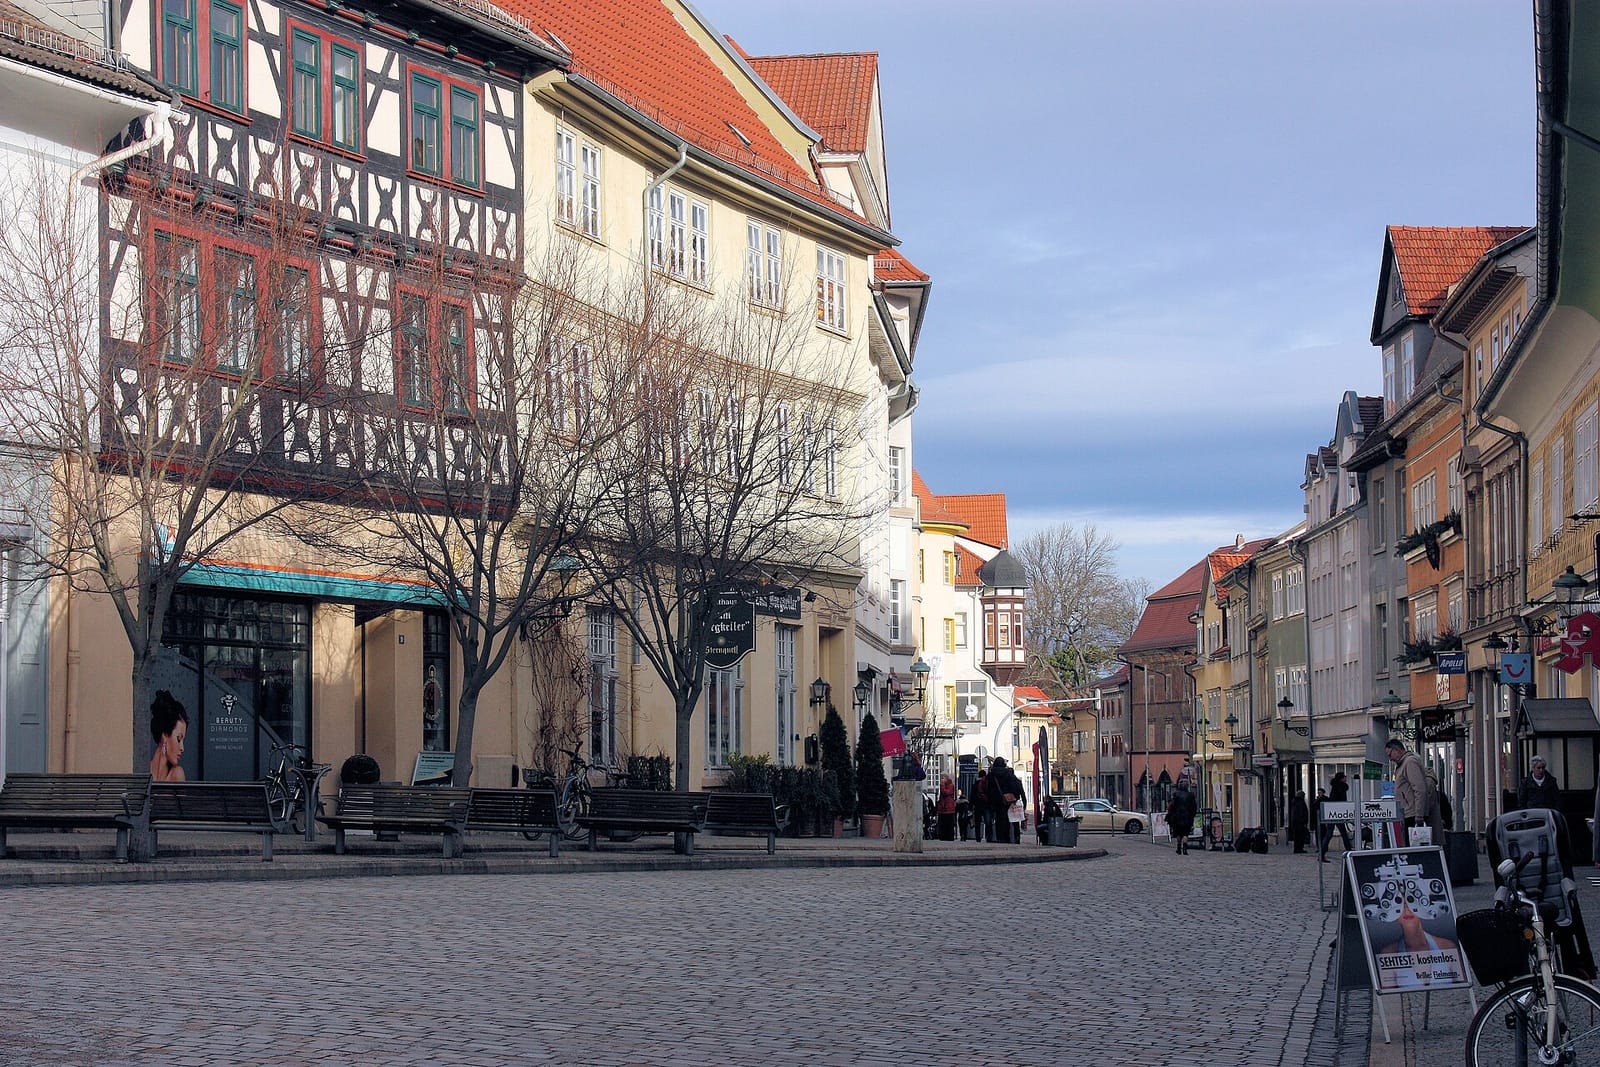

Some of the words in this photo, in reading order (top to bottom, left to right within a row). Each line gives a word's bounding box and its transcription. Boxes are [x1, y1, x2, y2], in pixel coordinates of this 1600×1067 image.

[1328, 809, 1392, 819] Modelauwelt
[1380, 955, 1415, 967] SEHTEST:
[1416, 952, 1457, 965] kostenlos.
